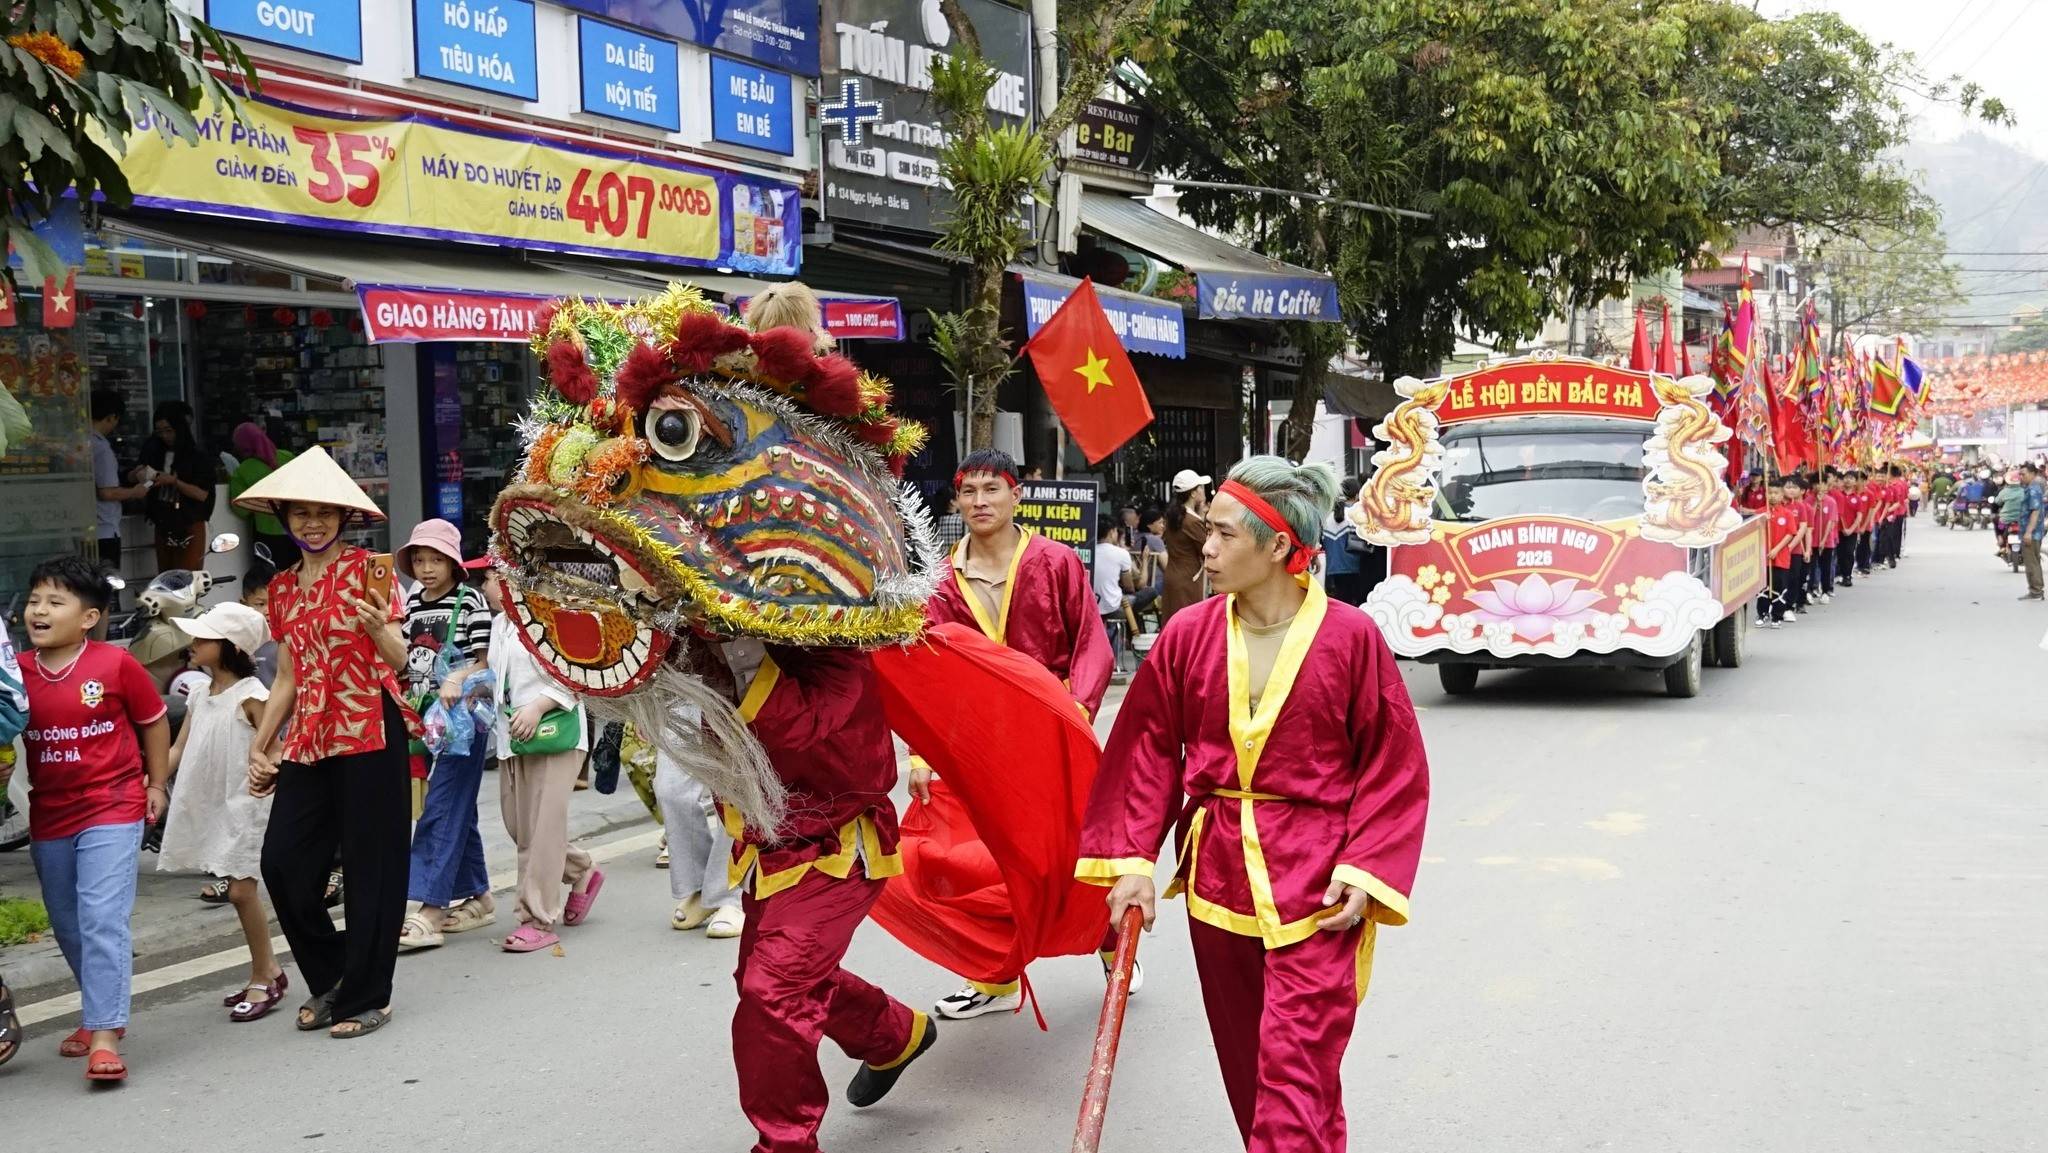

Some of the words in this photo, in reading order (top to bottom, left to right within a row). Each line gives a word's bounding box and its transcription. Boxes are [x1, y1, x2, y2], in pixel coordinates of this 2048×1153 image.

[257, 1, 315, 37] GOUT
[444, 2, 470, 29] HÔ
[474, 7, 508, 38] HẤP
[440, 43, 473, 75] TIÊU
[477, 51, 515, 84] HÓA
[605, 43, 625, 67] DA
[628, 43, 654, 74] LIỄU
[836, 20, 906, 85] TUẤN
[605, 80, 631, 111] NỘI
[633, 85, 658, 113] TIẾT
[730, 75, 748, 104] MẸ
[736, 112, 754, 136] EM
[756, 113, 771, 138] BÉ
[1087, 104, 1140, 125] RESTAURANT
[1103, 124, 1135, 153] Bar
[216, 155, 257, 182] GIẢM
[262, 162, 298, 187] ĐẾN
[421, 153, 460, 180] MÁY
[464, 162, 489, 184] ĐO
[493, 165, 542, 192] HUYẾT
[898, 160, 910, 175] SIM
[911, 160, 920, 177] SỐ
[508, 196, 537, 219] GIẢM
[540, 202, 564, 222] ĐẾN
[1213, 280, 1246, 313] Bắc
[1251, 289, 1274, 314] Hà
[1278, 289, 1322, 315] Coffee
[377, 302, 428, 329] GIAO
[433, 298, 487, 331] HÀNG
[490, 303, 524, 338] TẬN
[1131, 312, 1158, 341] CHÍNH
[1157, 316, 1179, 344] HÃNG
[1451, 379, 1475, 410] LỄ
[1480, 379, 1516, 409] HỘI
[1521, 374, 1561, 404] ĐỀN
[1568, 375, 1608, 404] BẮC
[1613, 381, 1644, 408] HÀ
[1033, 487, 1057, 499] ANH
[1060, 489, 1095, 501] STORE
[1014, 504, 1042, 521] PHỤ
[1046, 503, 1081, 522] KIỆN
[1044, 526, 1087, 544] THOẠI
[1467, 528, 1515, 556] XUÂN
[1517, 523, 1558, 544] BÍNH
[1561, 528, 1599, 555] NGỌ
[1516, 551, 1553, 567] 2026
[43, 725, 79, 744] CỘNG
[81, 719, 115, 739] ĐỒNG
[40, 746, 63, 763] BẮC
[65, 747, 81, 762] HÀ
